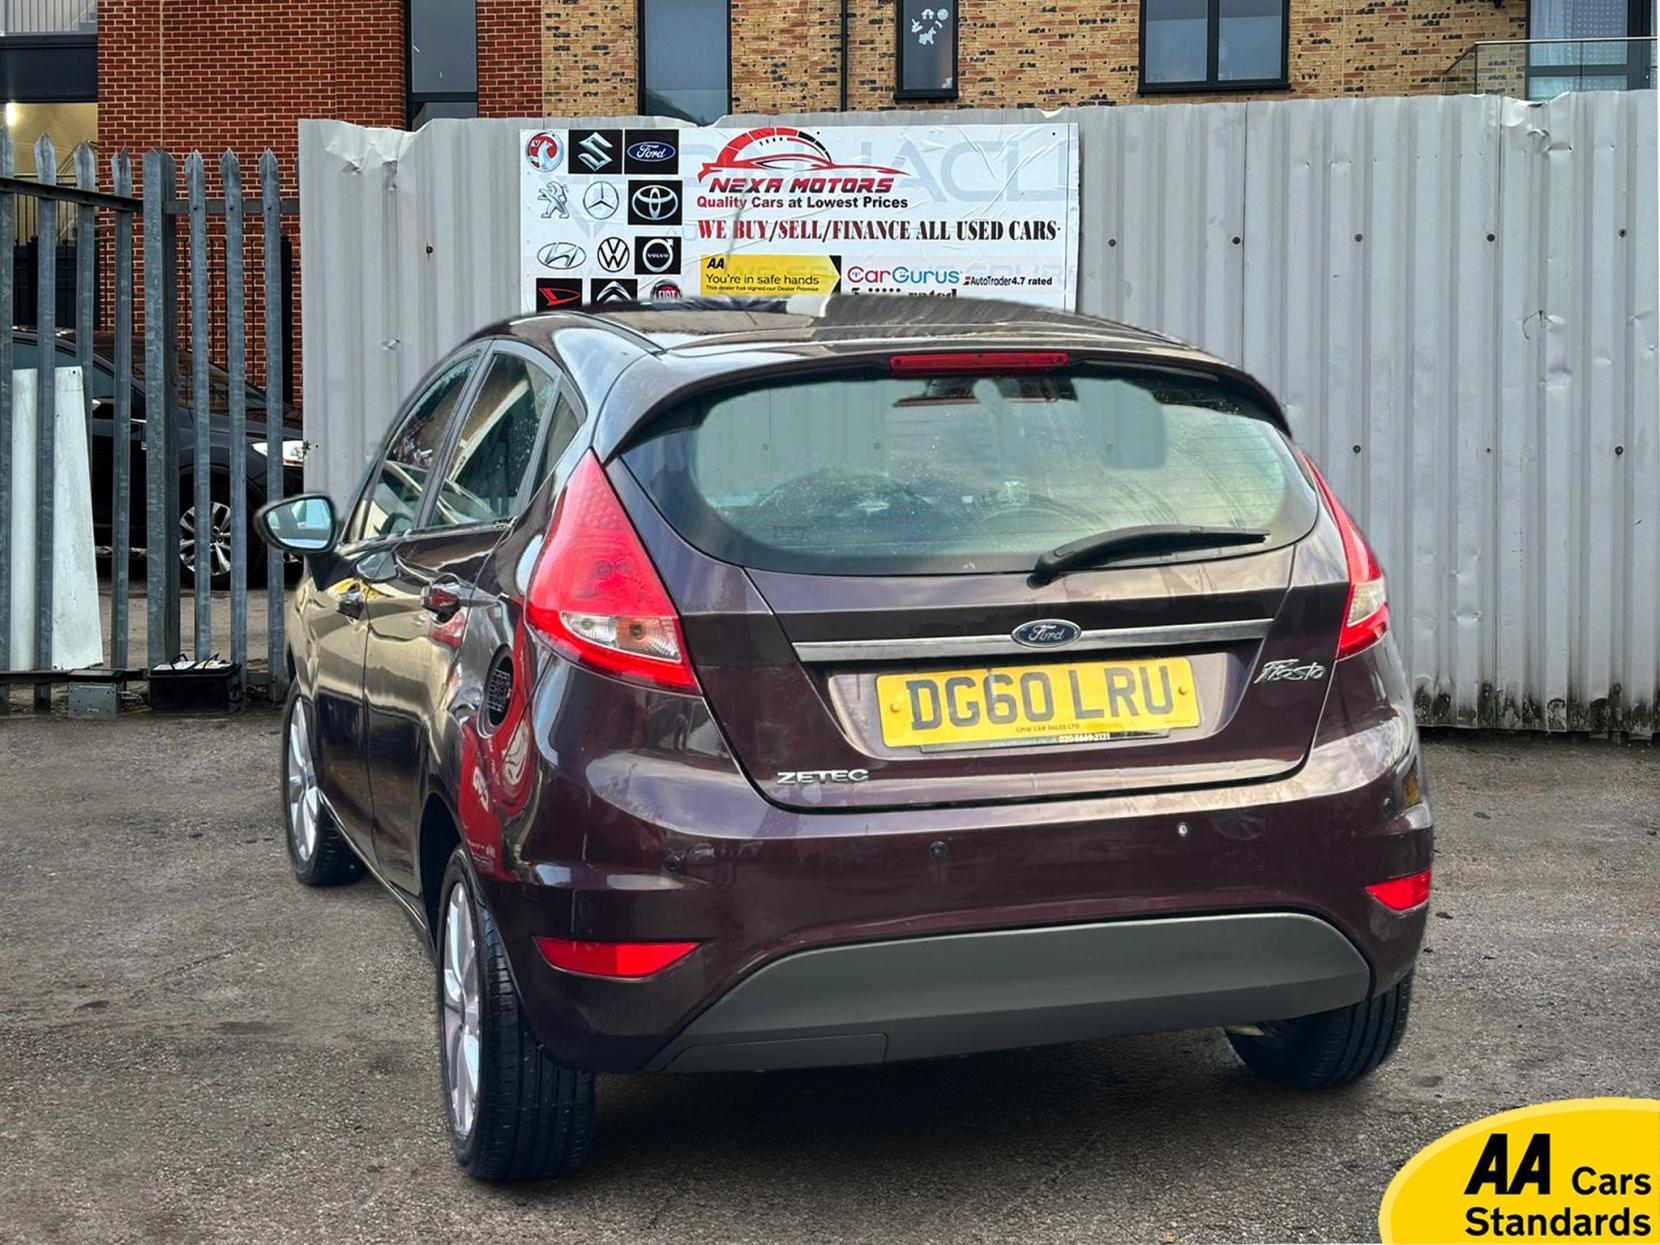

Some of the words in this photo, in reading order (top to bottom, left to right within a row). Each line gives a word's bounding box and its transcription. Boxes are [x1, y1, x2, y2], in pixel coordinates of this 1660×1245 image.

[637, 144, 666, 158] Ford
[709, 177, 784, 193] NEXA
[789, 177, 894, 194] MOTORS
[697, 196, 746, 211] Quality
[752, 197, 784, 208] Cars
[788, 197, 802, 208] at
[807, 197, 859, 209] Lowest
[863, 197, 908, 209] Prices
[697, 220, 727, 239] WE
[916, 220, 951, 240] ALL
[956, 220, 1003, 240] USED
[1008, 220, 1057, 240] CARS
[706, 257, 725, 269] AA
[706, 274, 741, 285] You're
[744, 274, 754, 284] in
[757, 274, 782, 285] safe
[783, 275, 820, 286] hands
[847, 265, 960, 285] CarGurus
[1027, 276, 1053, 286] rated
[1028, 624, 1066, 641] Ford
[906, 671, 1055, 731] DG60
[1069, 665, 1175, 720] LRU
[777, 769, 869, 785] ZETEC
